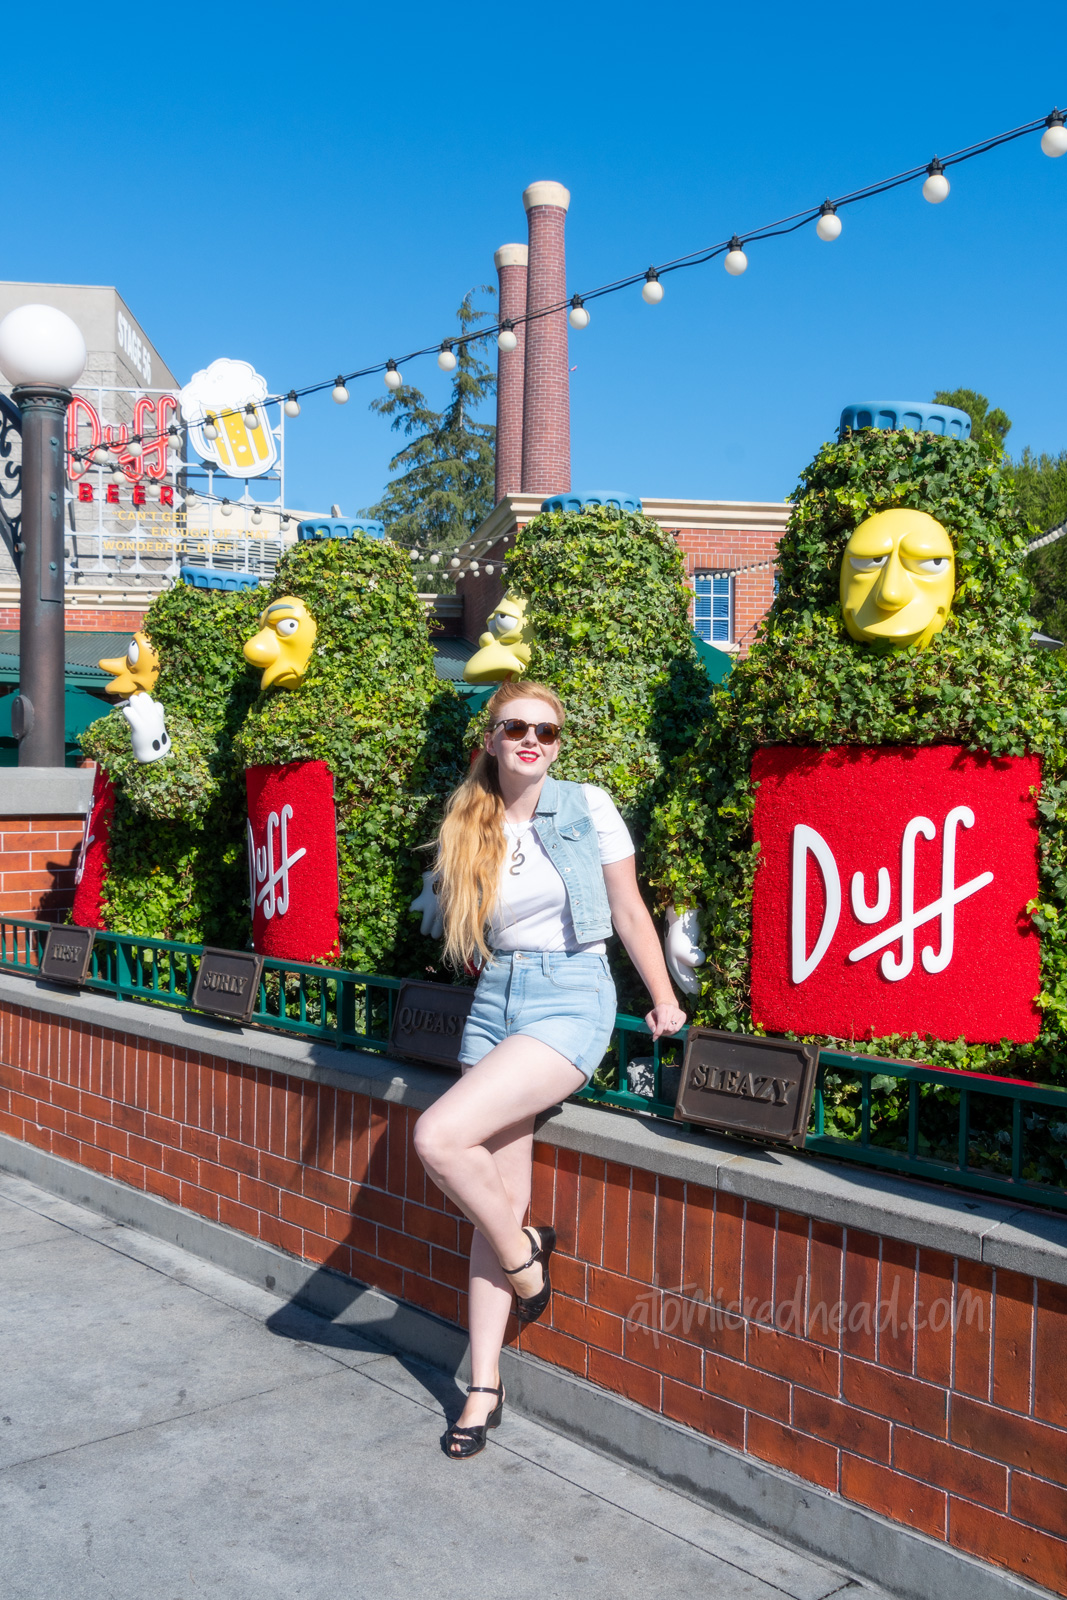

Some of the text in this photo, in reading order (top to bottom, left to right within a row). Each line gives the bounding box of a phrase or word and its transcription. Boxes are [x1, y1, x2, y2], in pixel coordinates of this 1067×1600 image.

[117, 310, 142, 373] STAGE
[67, 394, 177, 482] Duff
[78, 483, 174, 507] BEER
[161, 511, 188, 523] GET
[151, 526, 270, 540] ENOUGH OF THAT
[103, 541, 191, 553] WONDERFUL
[791, 805, 994, 984] Duff
[203, 970, 248, 995] SURLY
[691, 1063, 797, 1106] SLEAZY
